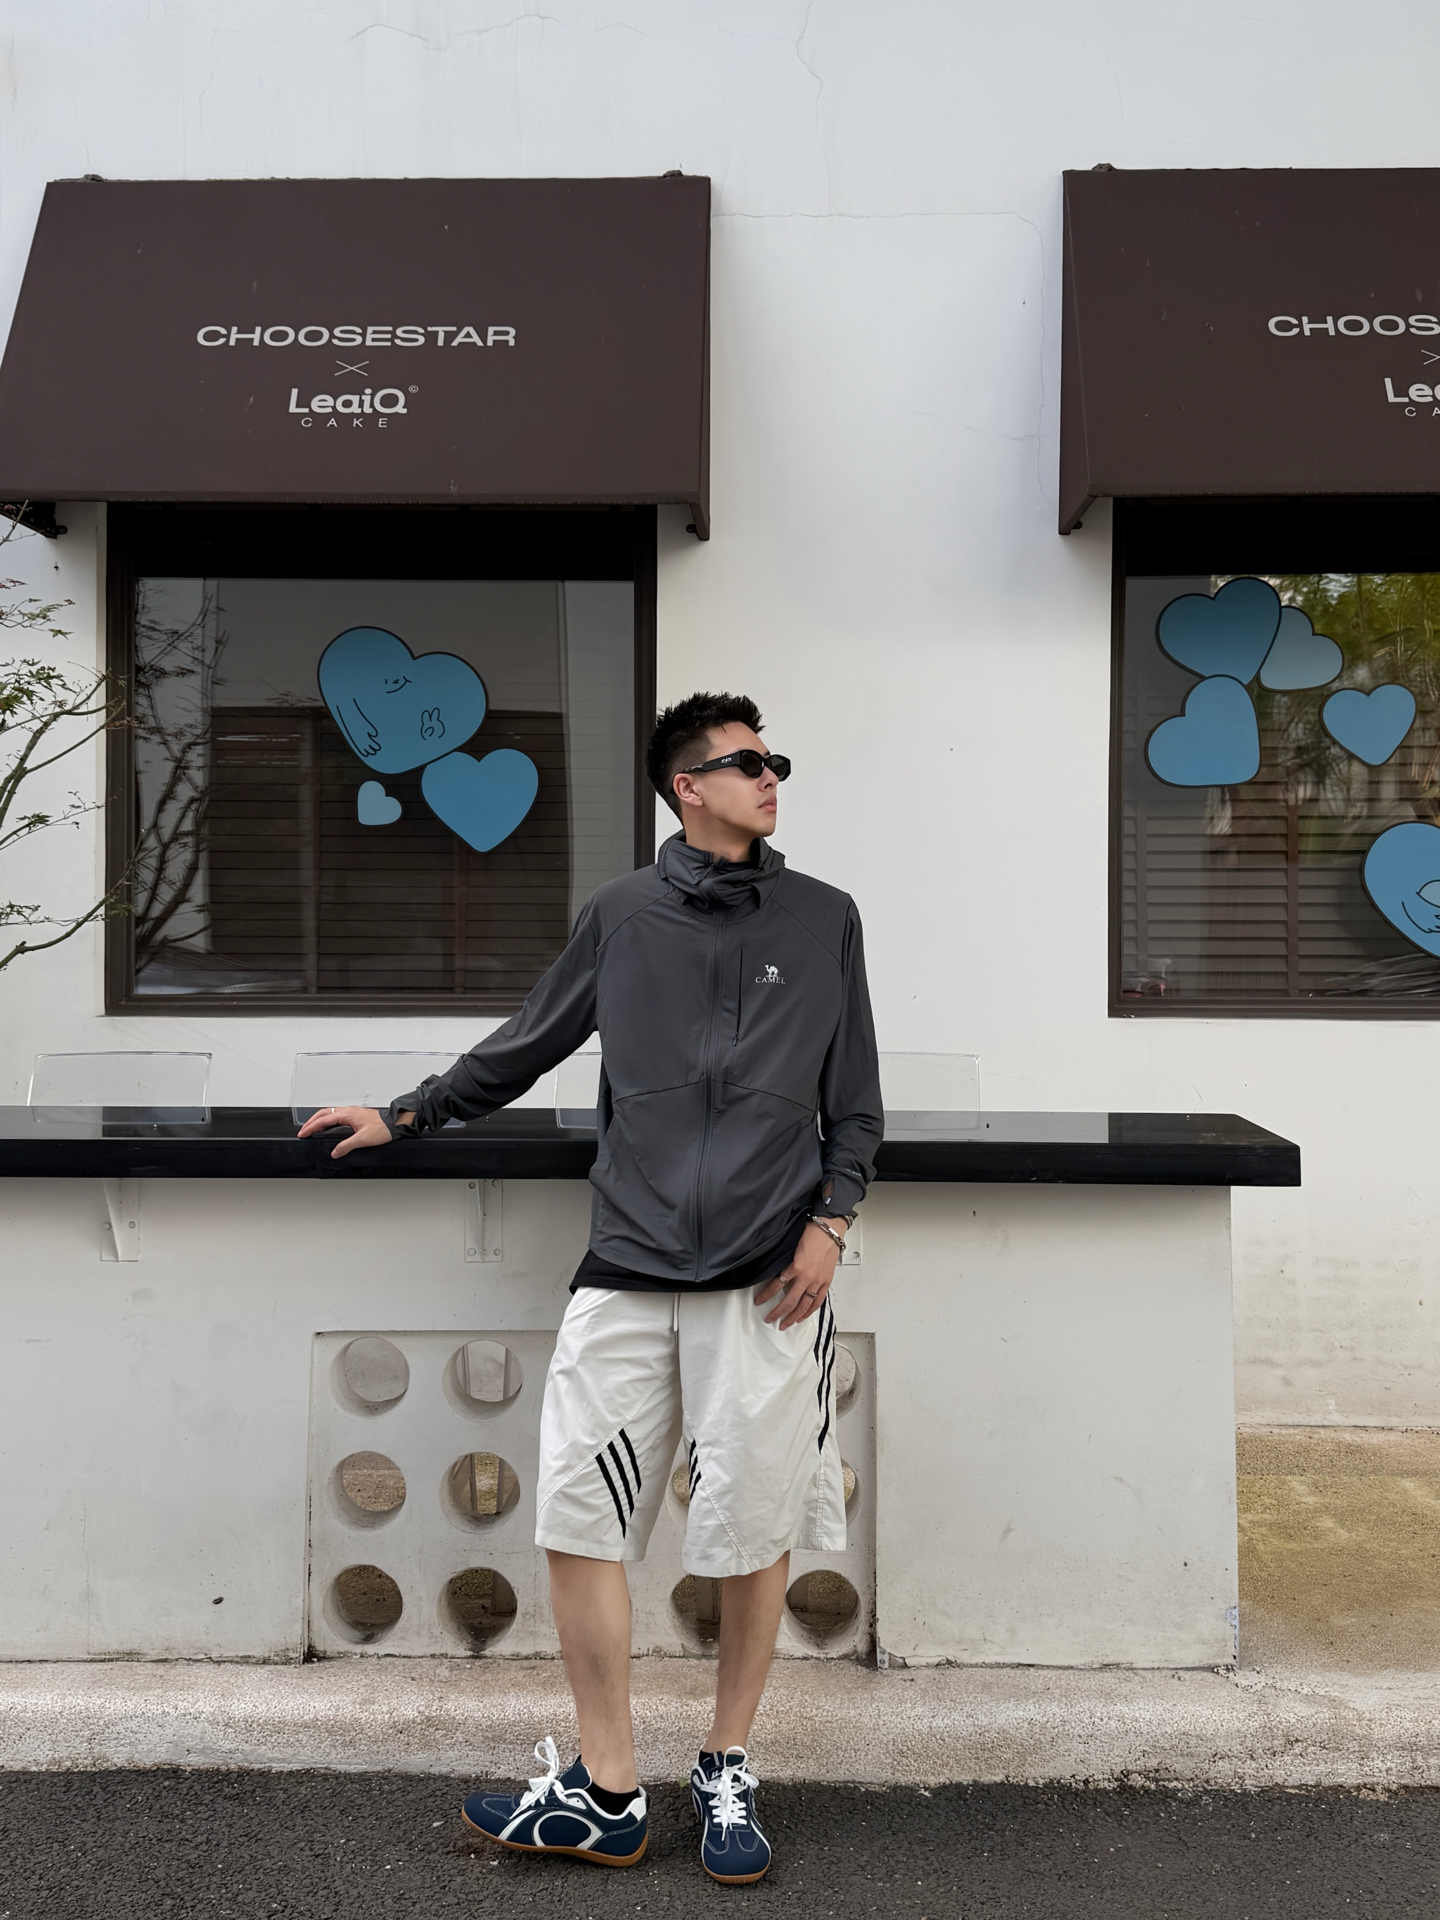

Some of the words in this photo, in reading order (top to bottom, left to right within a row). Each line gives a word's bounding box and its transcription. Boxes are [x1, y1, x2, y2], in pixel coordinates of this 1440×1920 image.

[196, 325, 517, 347] CHOOSESTAR
[288, 387, 408, 414] LeaiQ
[1384, 377, 1440, 403] Le
[300, 417, 389, 428] CAKE
[755, 976, 786, 985] CAMEL
